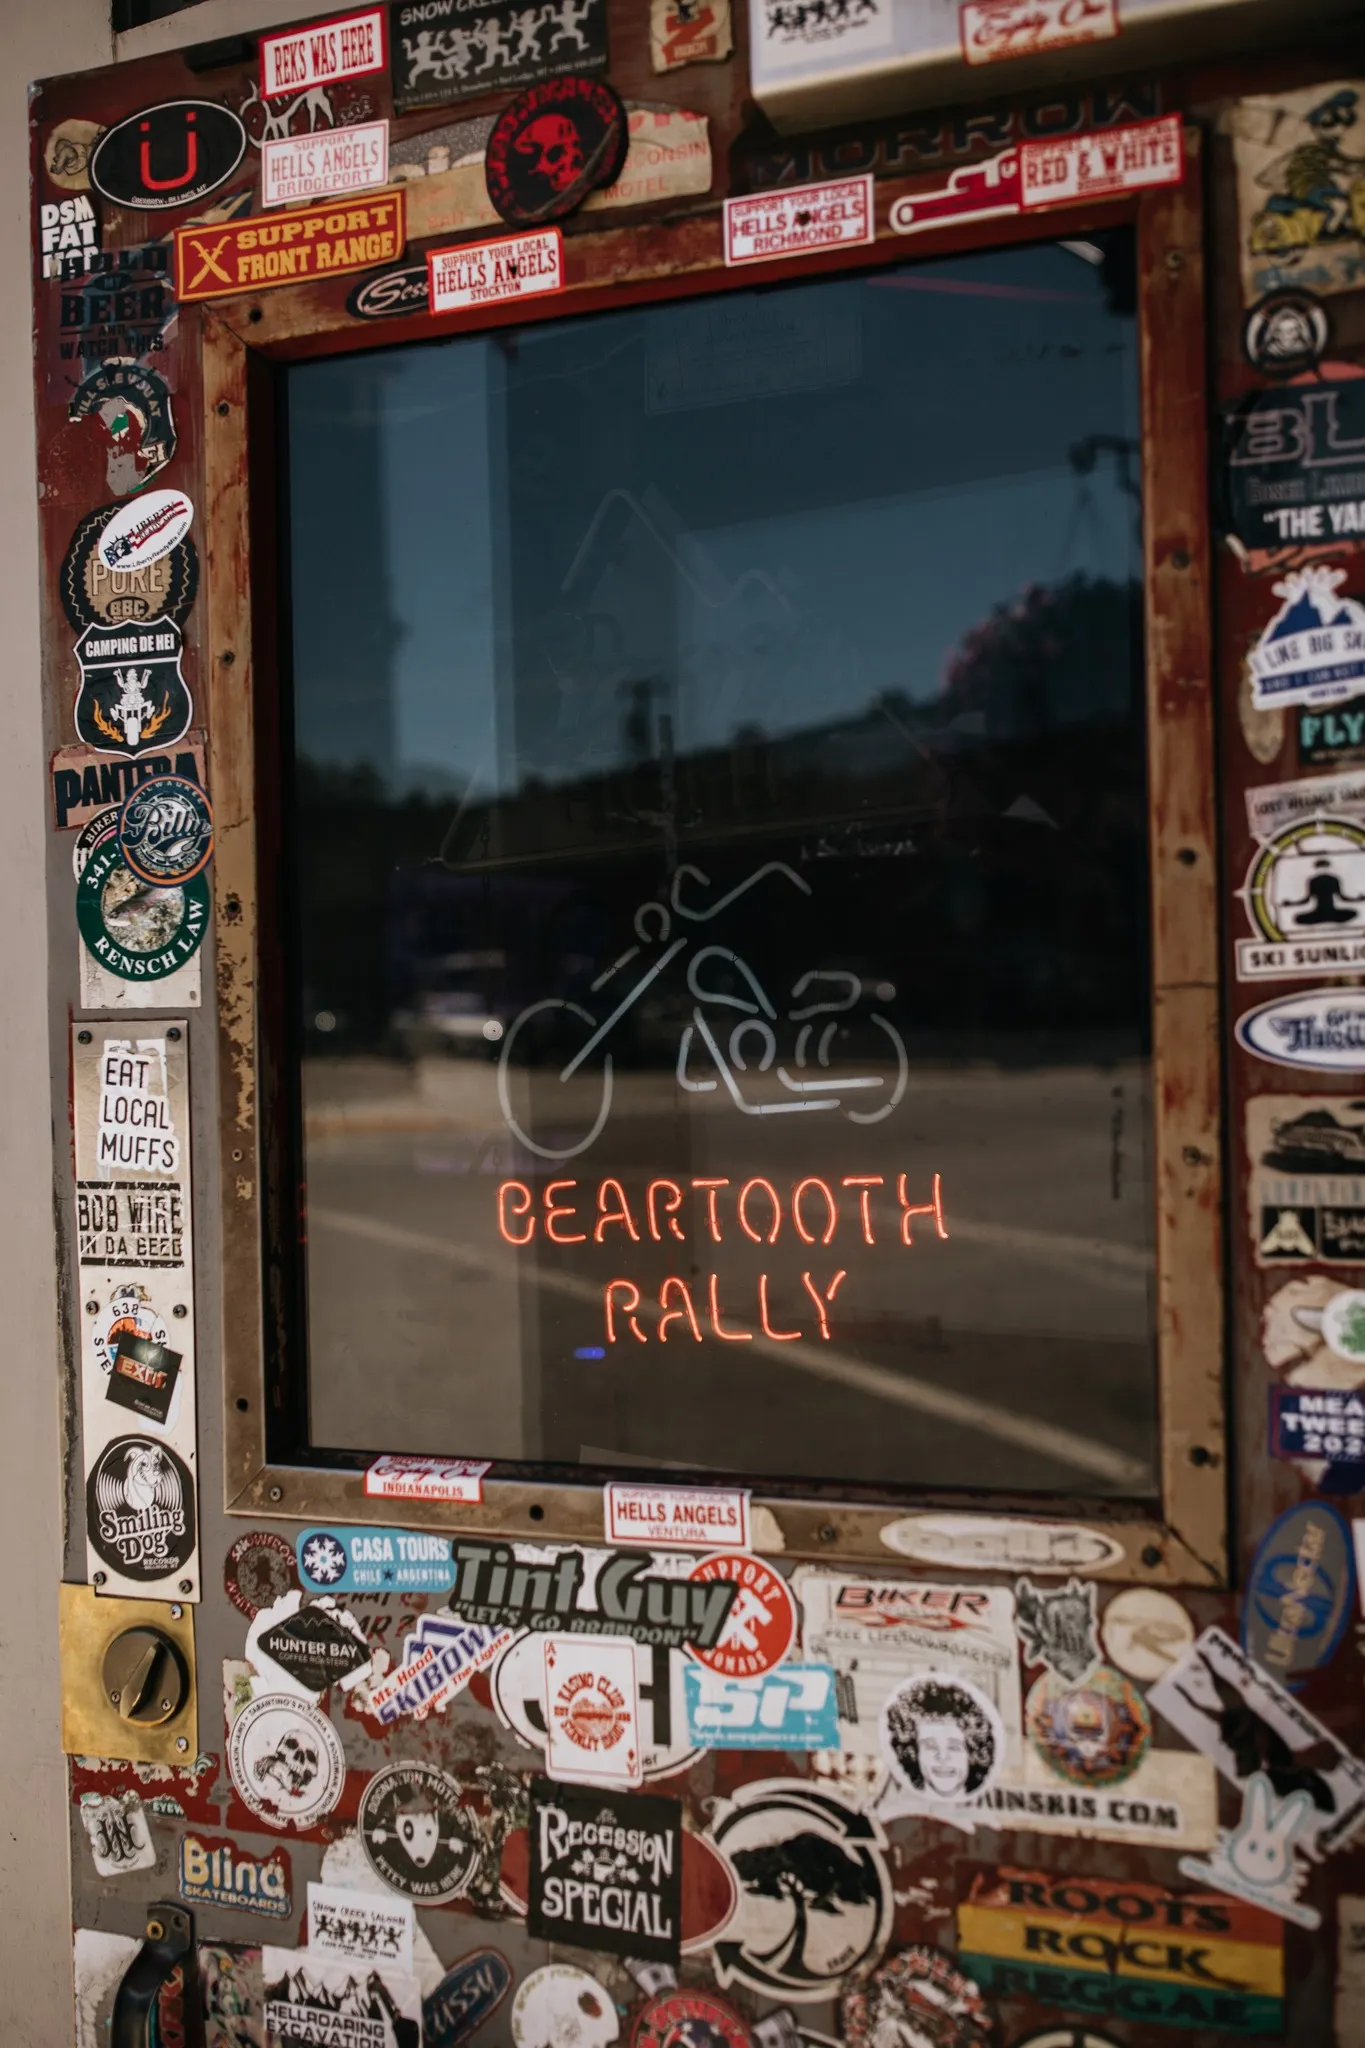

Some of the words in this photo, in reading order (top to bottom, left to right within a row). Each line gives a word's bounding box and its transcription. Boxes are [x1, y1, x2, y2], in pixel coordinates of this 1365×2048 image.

[400, 0, 453, 27] SNOW
[310, 30, 338, 76] WAS
[341, 22, 375, 68] HERE
[293, 133, 356, 150] SUPPORT
[271, 154, 316, 184] HELLS
[322, 141, 379, 171] ANGELS
[1026, 157, 1068, 188] RED
[1078, 151, 1091, 177] &
[1101, 137, 1175, 174] WHITE
[276, 169, 374, 198] BRIDGEPORT
[41, 196, 95, 229] DSM
[236, 205, 394, 250] SUPPORT
[733, 212, 787, 237] HELLS
[792, 199, 865, 227] ANGELS
[41, 220, 97, 252] FAT
[441, 250, 484, 270] SUPPORT
[488, 244, 513, 261] YOUR
[517, 237, 549, 255] LOCAL
[754, 224, 842, 251] RICHMOND
[237, 242, 311, 283] FRONT
[316, 231, 395, 266] RANGE
[436, 264, 487, 295] HELLS
[494, 250, 557, 283] ANGELS
[470, 281, 522, 301] STOCKTON
[129, 500, 178, 537] LIBERTY
[92, 558, 165, 596] PURE
[110, 599, 145, 617] BBC
[85, 636, 139, 658] CAMPING
[139, 635, 155, 653] DE
[156, 633, 176, 652] HEI
[84, 812, 119, 844] BIKER
[94, 935, 178, 976] RENSCH
[177, 899, 204, 953] LAW
[1250, 950, 1285, 967] SKI
[105, 1057, 149, 1089] EAT
[103, 1095, 169, 1130] LOCAL
[101, 1132, 175, 1168] MUFFS
[78, 1193, 119, 1232] BOB
[497, 1172, 950, 1246] BEARTOOTH
[80, 1236, 97, 1256] IN
[106, 1236, 129, 1256] DA
[112, 1302, 140, 1318] 638
[605, 1269, 848, 1344] RALLY
[383, 1482, 464, 1497] INDIANAPOLIS
[100, 1503, 186, 1543] Smiling
[617, 1501, 666, 1522] HELLS
[673, 1504, 737, 1527] ANGELS
[117, 1529, 169, 1565] Dog
[351, 1536, 394, 1562] CASA
[396, 1537, 450, 1562] TOURS
[648, 1525, 707, 1540] VENTURA
[353, 1569, 381, 1583] CHILE
[397, 1569, 451, 1583] ARGENTINA
[692, 1559, 782, 1603] UPPORT
[457, 1545, 578, 1612] Tint
[600, 1558, 735, 1646] Guy
[836, 1586, 990, 1616] BIKER
[530, 1613, 560, 1631] GO
[269, 1636, 326, 1656] HUNTER
[330, 1641, 359, 1658] BAY
[452, 1665, 473, 1686] The
[473, 1631, 511, 1668] Lights
[547, 1640, 557, 1656] A
[371, 1687, 398, 1706] Mt.
[396, 1647, 436, 1686] Hood
[536, 1802, 674, 1887] RECESSION
[374, 1854, 407, 1888] PETEY
[410, 1880, 441, 1895] WAS
[184, 1884, 287, 1912] SKATEBOARDS
[540, 1876, 673, 1940] SPECIAL
[1005, 1878, 1232, 1934] ROOTS
[1023, 1925, 1217, 1981] ROCK
[266, 2002, 386, 2040] HELLROARING
